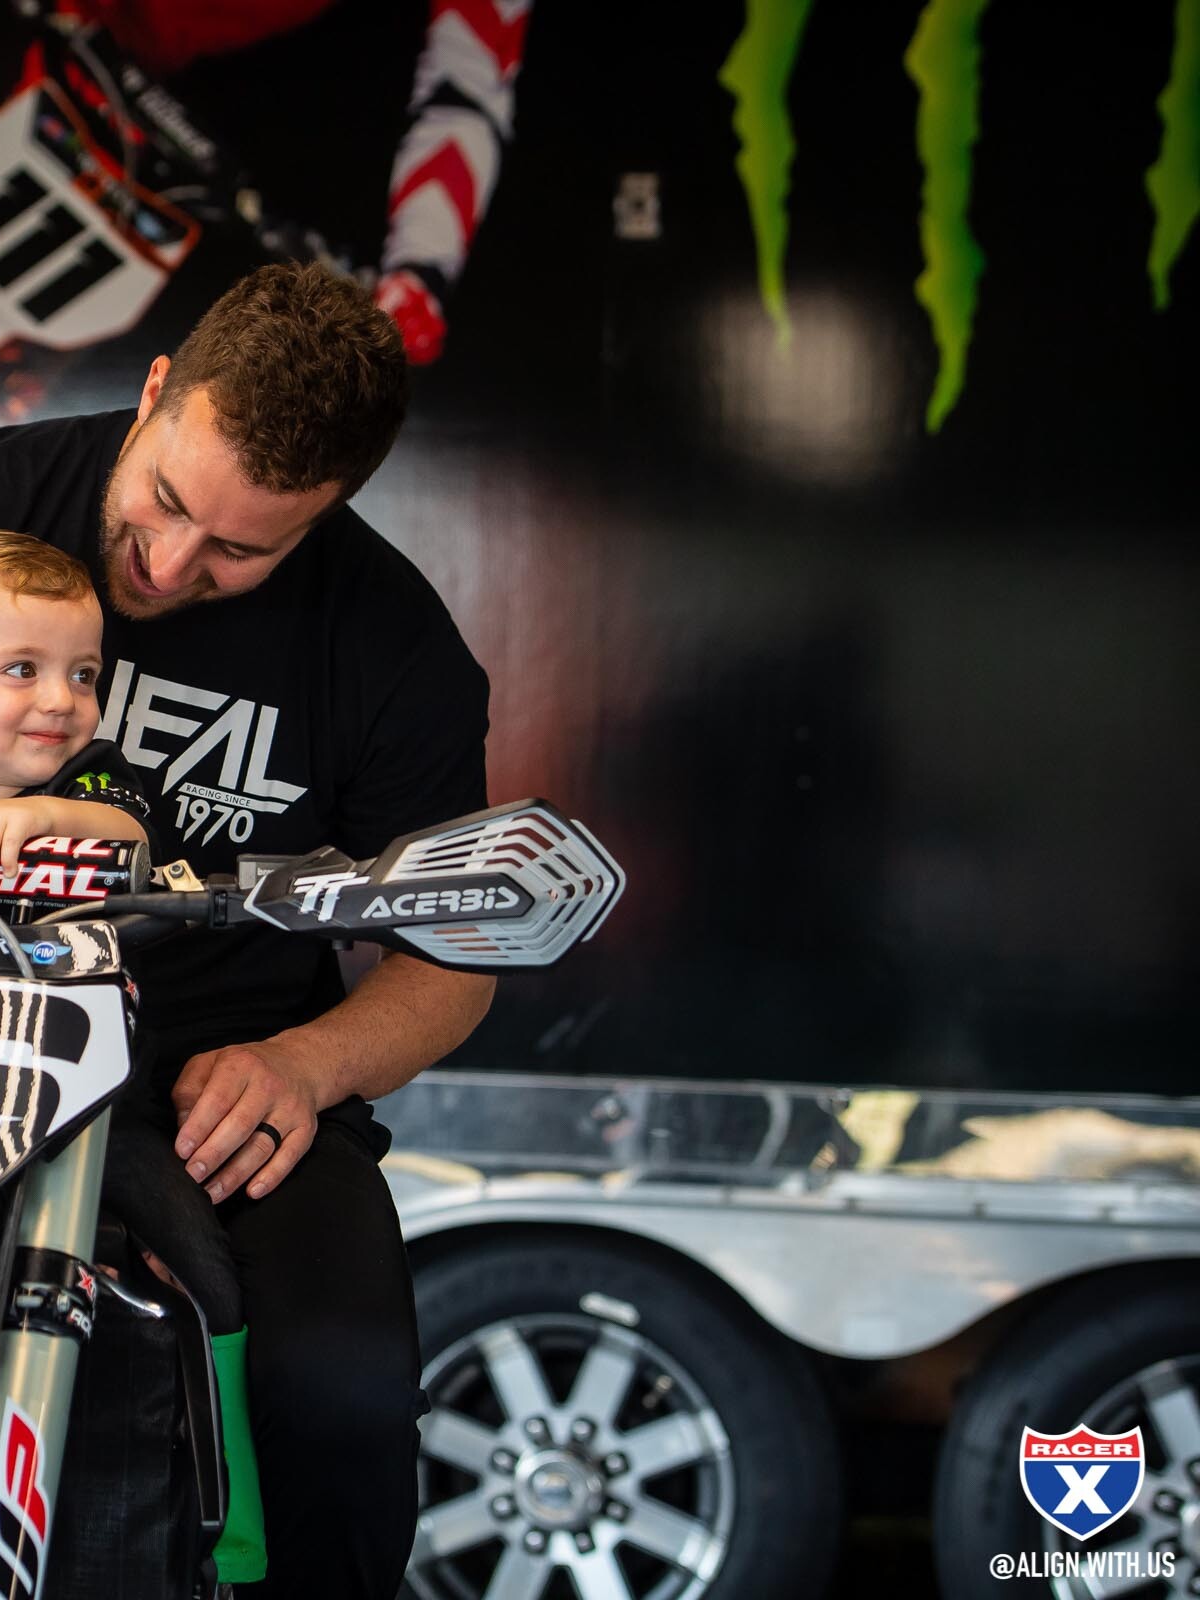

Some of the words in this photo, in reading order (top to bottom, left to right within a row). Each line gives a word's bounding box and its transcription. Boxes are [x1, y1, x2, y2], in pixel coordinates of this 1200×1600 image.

[185, 783, 222, 801] RACING
[224, 793, 252, 807] SINCE
[175, 794, 255, 848] 1970
[35, 948, 54, 958] FIM
